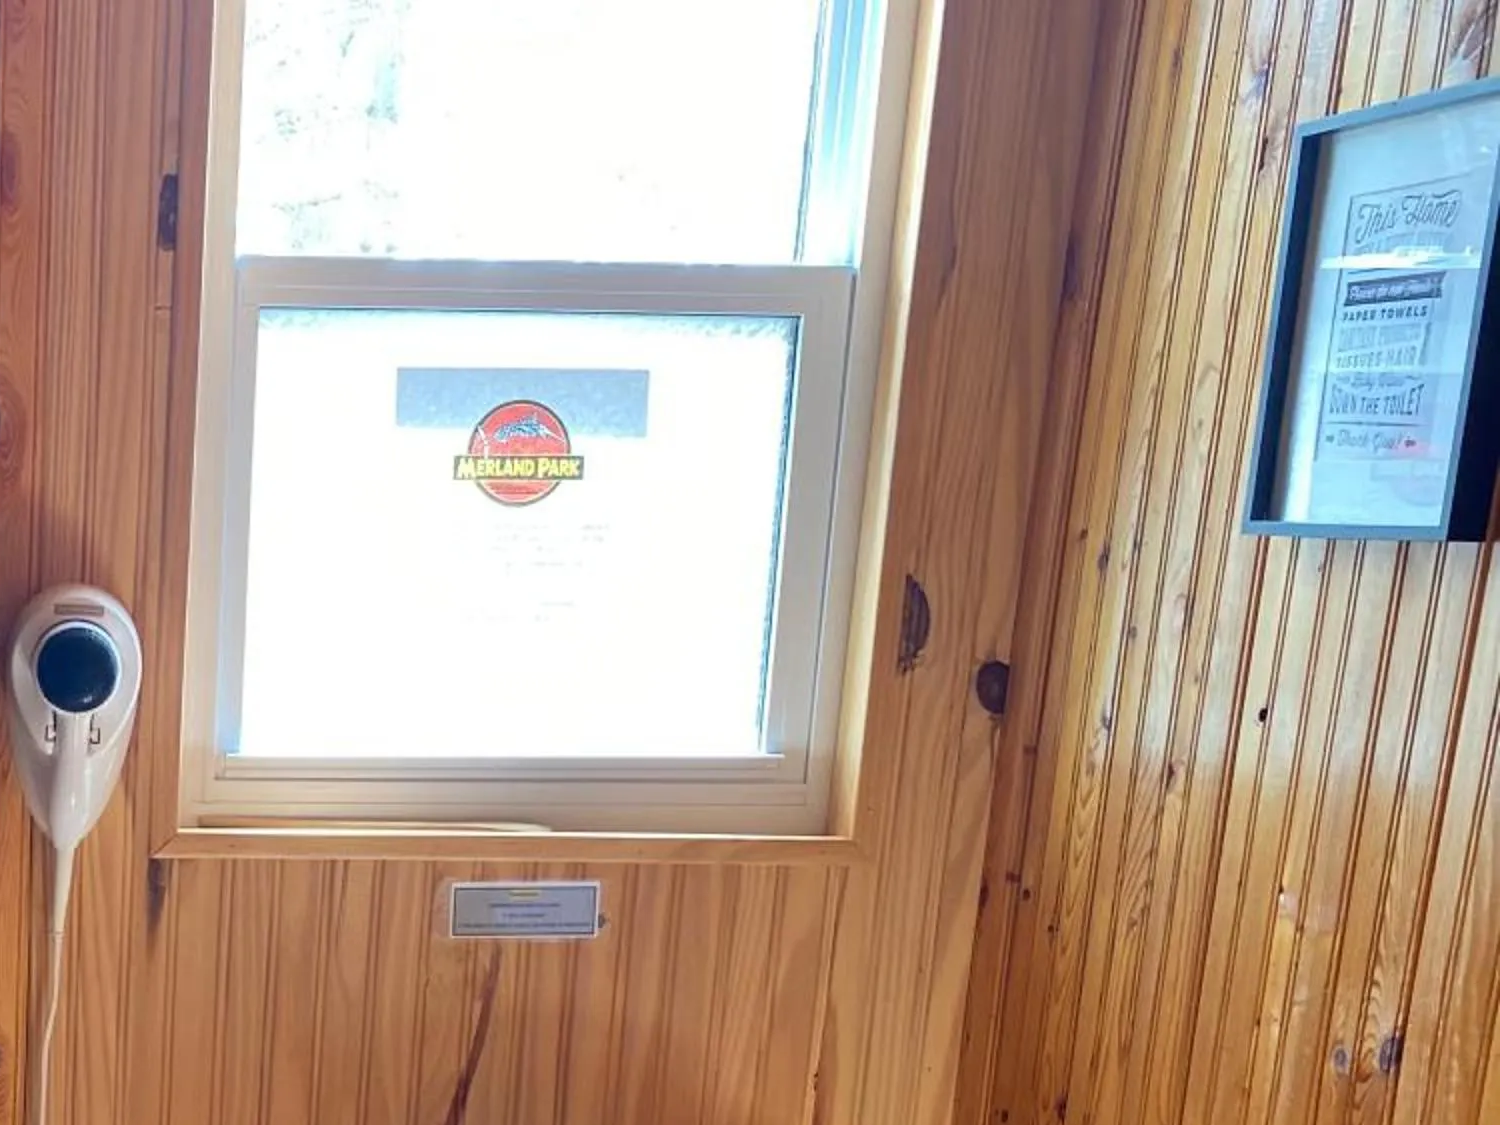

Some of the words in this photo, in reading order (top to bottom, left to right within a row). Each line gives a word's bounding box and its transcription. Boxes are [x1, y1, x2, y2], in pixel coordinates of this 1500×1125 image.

[1355, 202, 1397, 244] This
[1401, 189, 1461, 228] Home
[1341, 308, 1377, 322] PAPER
[1380, 304, 1429, 320] TOWELS
[1360, 395, 1381, 415] THE
[1383, 382, 1426, 417] TOILET
[457, 456, 535, 479] MERLAND
[537, 456, 580, 479] PARK
